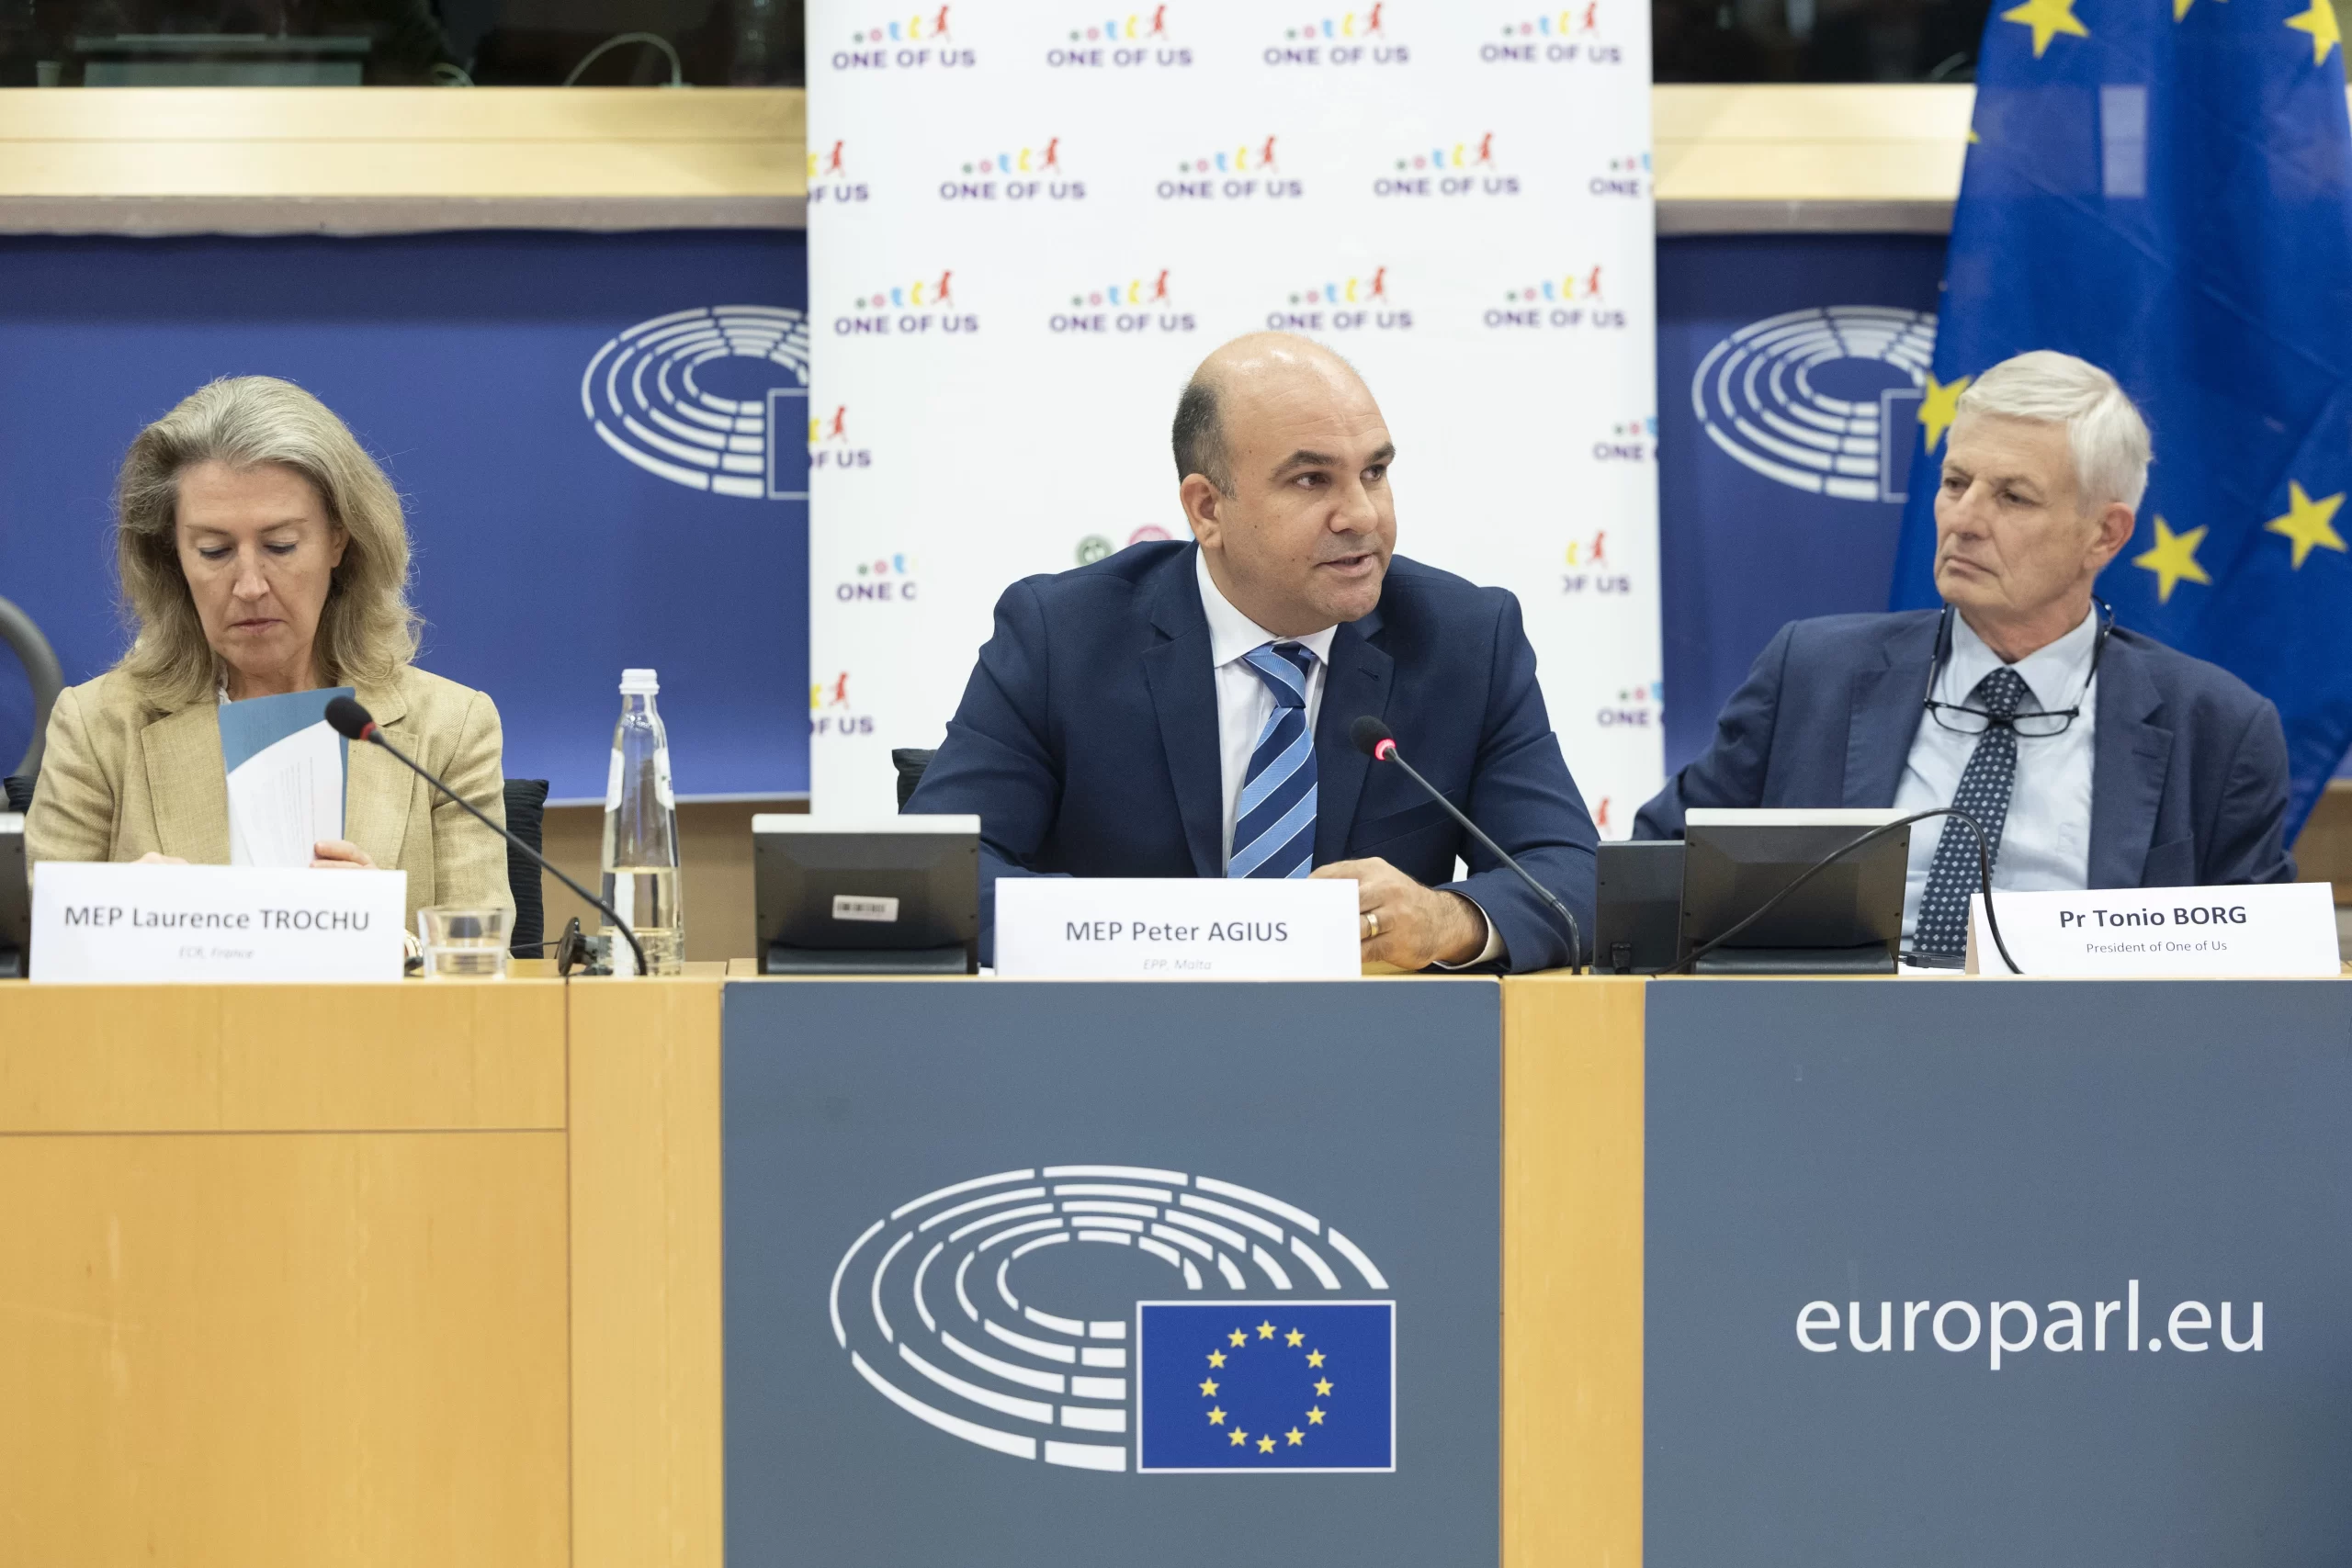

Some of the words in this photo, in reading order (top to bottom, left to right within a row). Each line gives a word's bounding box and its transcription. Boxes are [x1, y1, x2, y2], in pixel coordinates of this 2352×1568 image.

[831, 51, 886, 71] ONE
[895, 49, 931, 68] OF
[939, 49, 977, 68] US
[1046, 49, 1102, 67] ONE
[1112, 47, 1148, 68] OF
[1156, 48, 1193, 67] US
[1263, 47, 1320, 65] ONE
[1329, 46, 1364, 66] OF
[1373, 45, 1410, 65] US
[1479, 43, 1536, 63] ONE
[1545, 43, 1580, 63] OF
[1588, 46, 1623, 65] US
[807, 186, 827, 203] F
[833, 183, 870, 203] US
[939, 182, 995, 200] ONE
[1005, 181, 1041, 200] OF
[1048, 181, 1087, 200] US
[1157, 180, 1213, 199] ONE
[1222, 179, 1258, 199] OF
[1265, 179, 1304, 198] US
[1374, 177, 1430, 197] ONE
[1440, 175, 1475, 197] OF
[1483, 176, 1521, 196] US
[1589, 177, 1640, 198] ONE
[833, 315, 888, 335] ONE
[898, 314, 933, 333] OF
[942, 314, 979, 333] US
[1049, 314, 1105, 333] ONE
[1115, 313, 1151, 333] OF
[1159, 312, 1197, 333] US
[1266, 312, 1322, 332] ONE
[1332, 310, 1367, 331] OF
[1375, 310, 1414, 330] US
[1483, 308, 1541, 328] ONE
[1549, 308, 1584, 328] OF
[1591, 310, 1628, 330] US
[808, 449, 829, 469] F
[836, 449, 872, 469] US
[1593, 443, 1644, 463] ONE
[836, 582, 890, 602] ONE
[1596, 575, 1632, 595] US
[809, 716, 830, 736] F
[838, 716, 875, 736] US
[1597, 708, 1649, 728] ONE
[64, 906, 123, 927] MEP
[132, 907, 250, 930] Laurence
[260, 909, 369, 931] TROCHU
[2059, 910, 2086, 929] Pr
[2092, 908, 2165, 928] Tonio
[2173, 906, 2247, 925] BORG
[1066, 921, 1123, 942] MEP
[1132, 921, 1200, 942] Peter
[1207, 921, 1288, 942] AGIUS
[2086, 942, 2146, 953] President
[2149, 941, 2162, 953] of
[2165, 941, 2191, 952] One
[2195, 940, 2208, 952] of
[2211, 941, 2228, 951] Us
[1142, 958, 1170, 971] EPP,
[1173, 958, 1213, 971] Malta
[1795, 1280, 2264, 1371] europarl.eu
